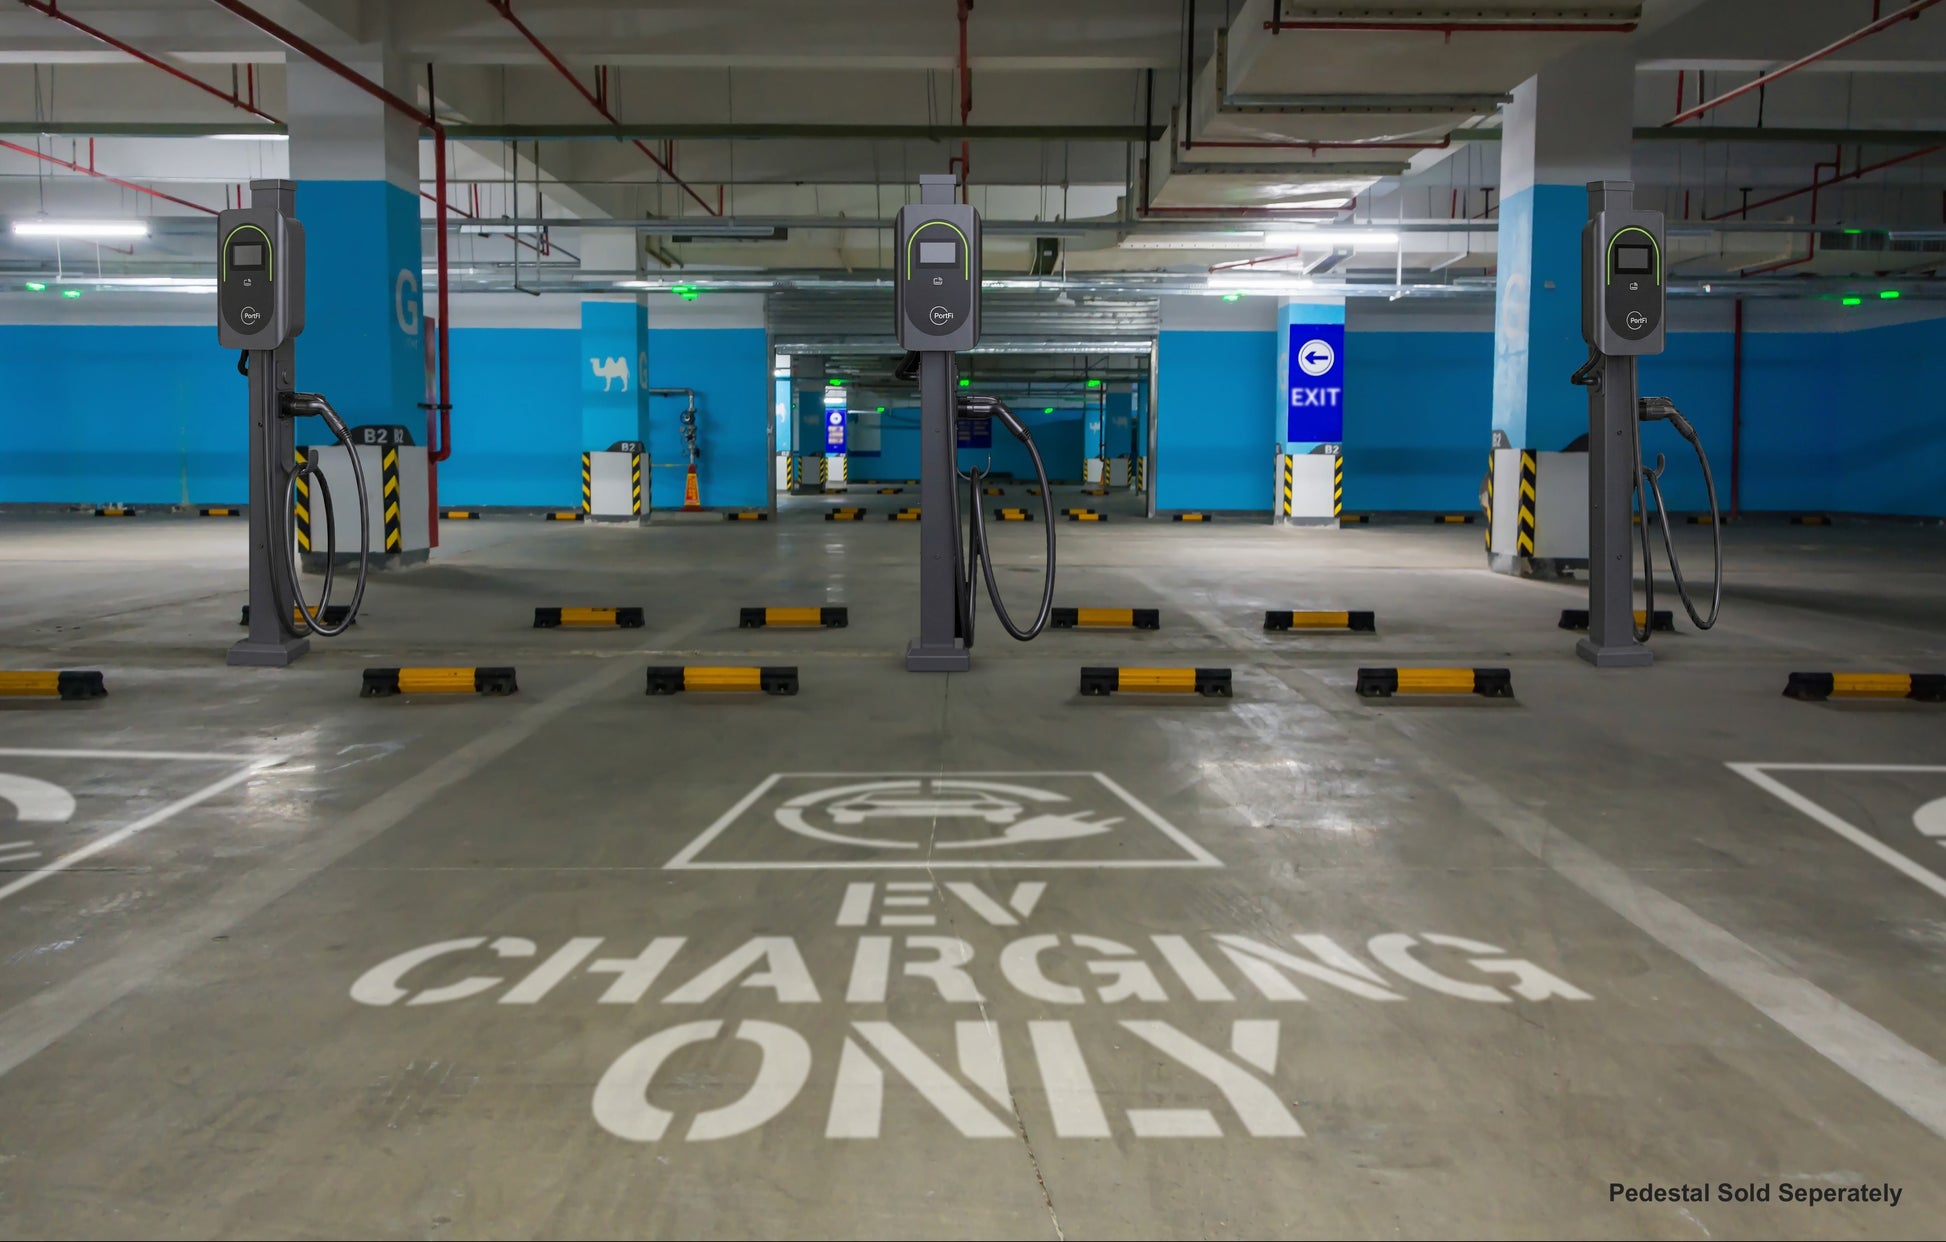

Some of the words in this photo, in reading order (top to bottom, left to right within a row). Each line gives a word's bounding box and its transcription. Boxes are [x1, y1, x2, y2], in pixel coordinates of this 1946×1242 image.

[395, 268, 418, 335] G
[244, 312, 260, 320] PortFi
[934, 312, 954, 320] PortFi
[1630, 316, 1648, 324] PortFi
[1291, 387, 1341, 407] EXIT
[364, 428, 388, 443] B2
[621, 442, 636, 452] B2
[1324, 444, 1340, 454] B2
[836, 882, 1046, 927] EV
[350, 931, 1594, 1005] CHARGING
[591, 1019, 1307, 1142] ONLY
